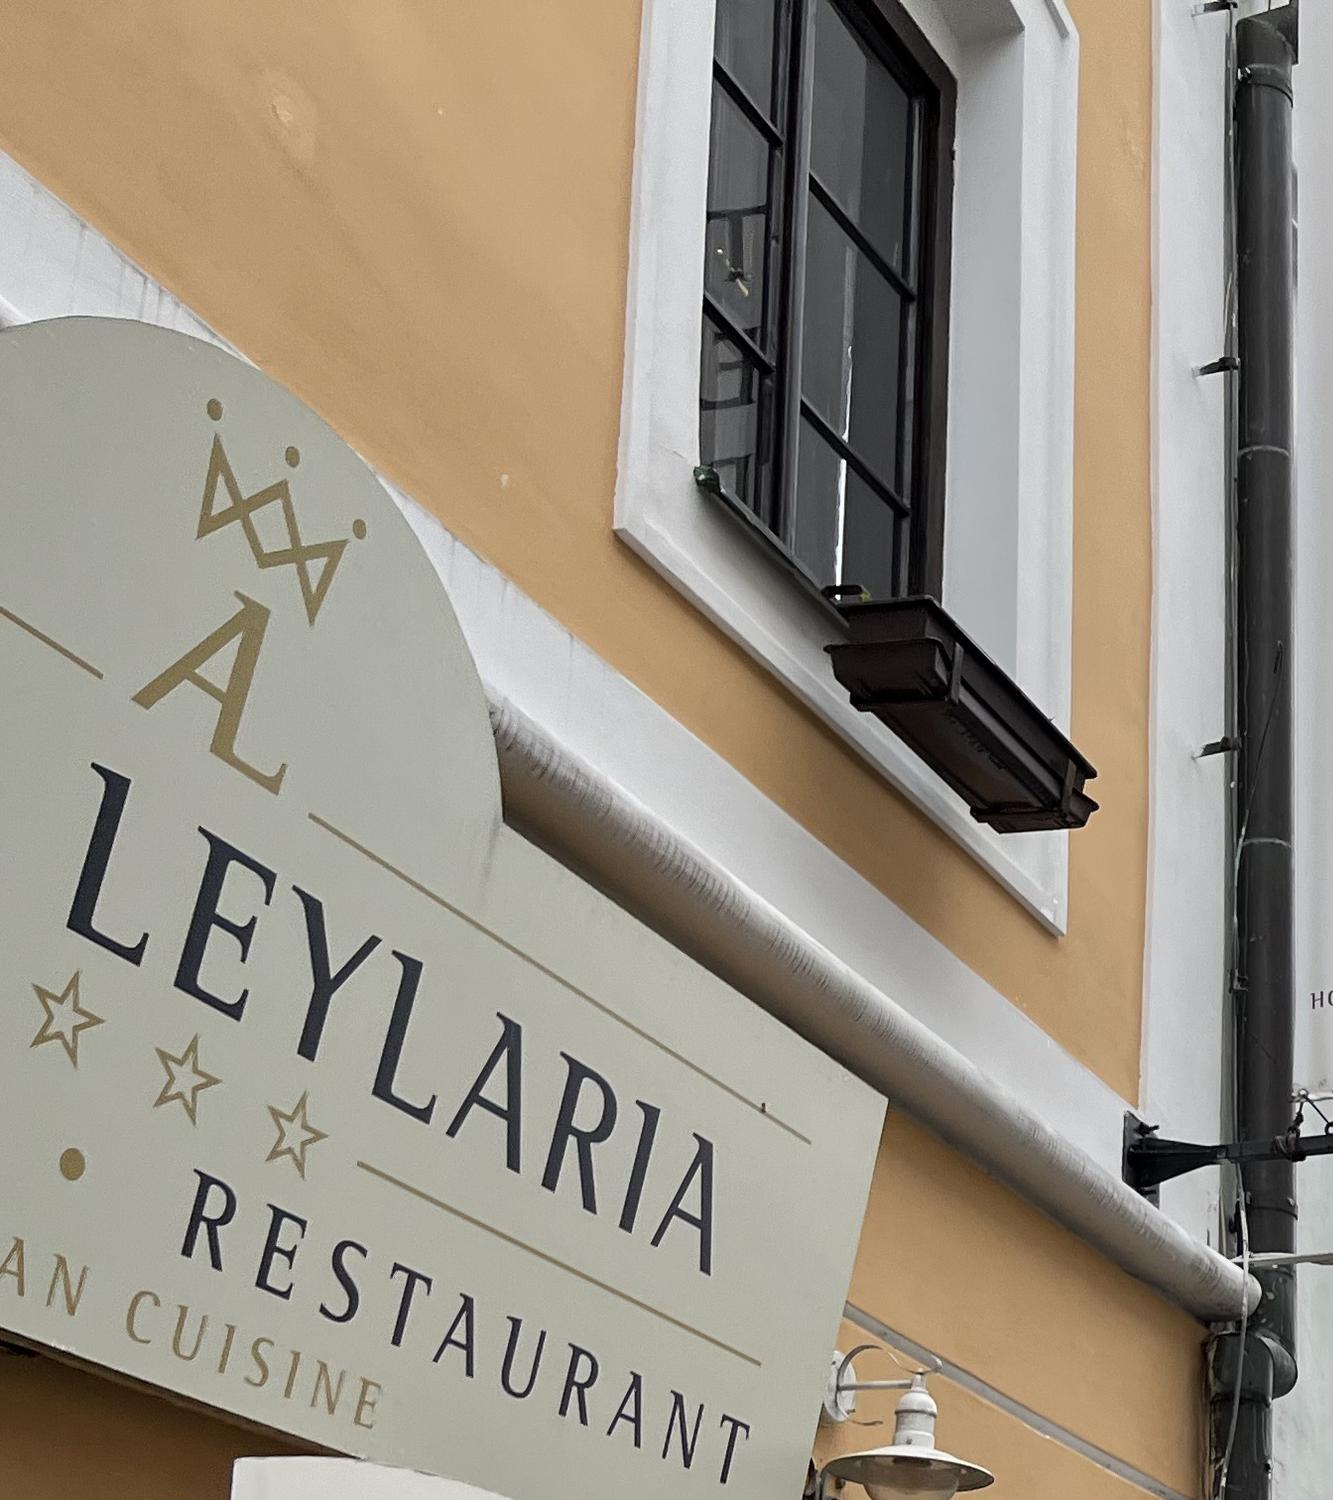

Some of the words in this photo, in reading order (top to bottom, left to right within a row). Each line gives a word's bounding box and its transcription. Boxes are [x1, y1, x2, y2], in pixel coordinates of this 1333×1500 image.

[66, 761, 724, 1277] LEYLARIA
[125, 1290, 384, 1431] CUISINE
[180, 1168, 751, 1485] RESTAURANT
